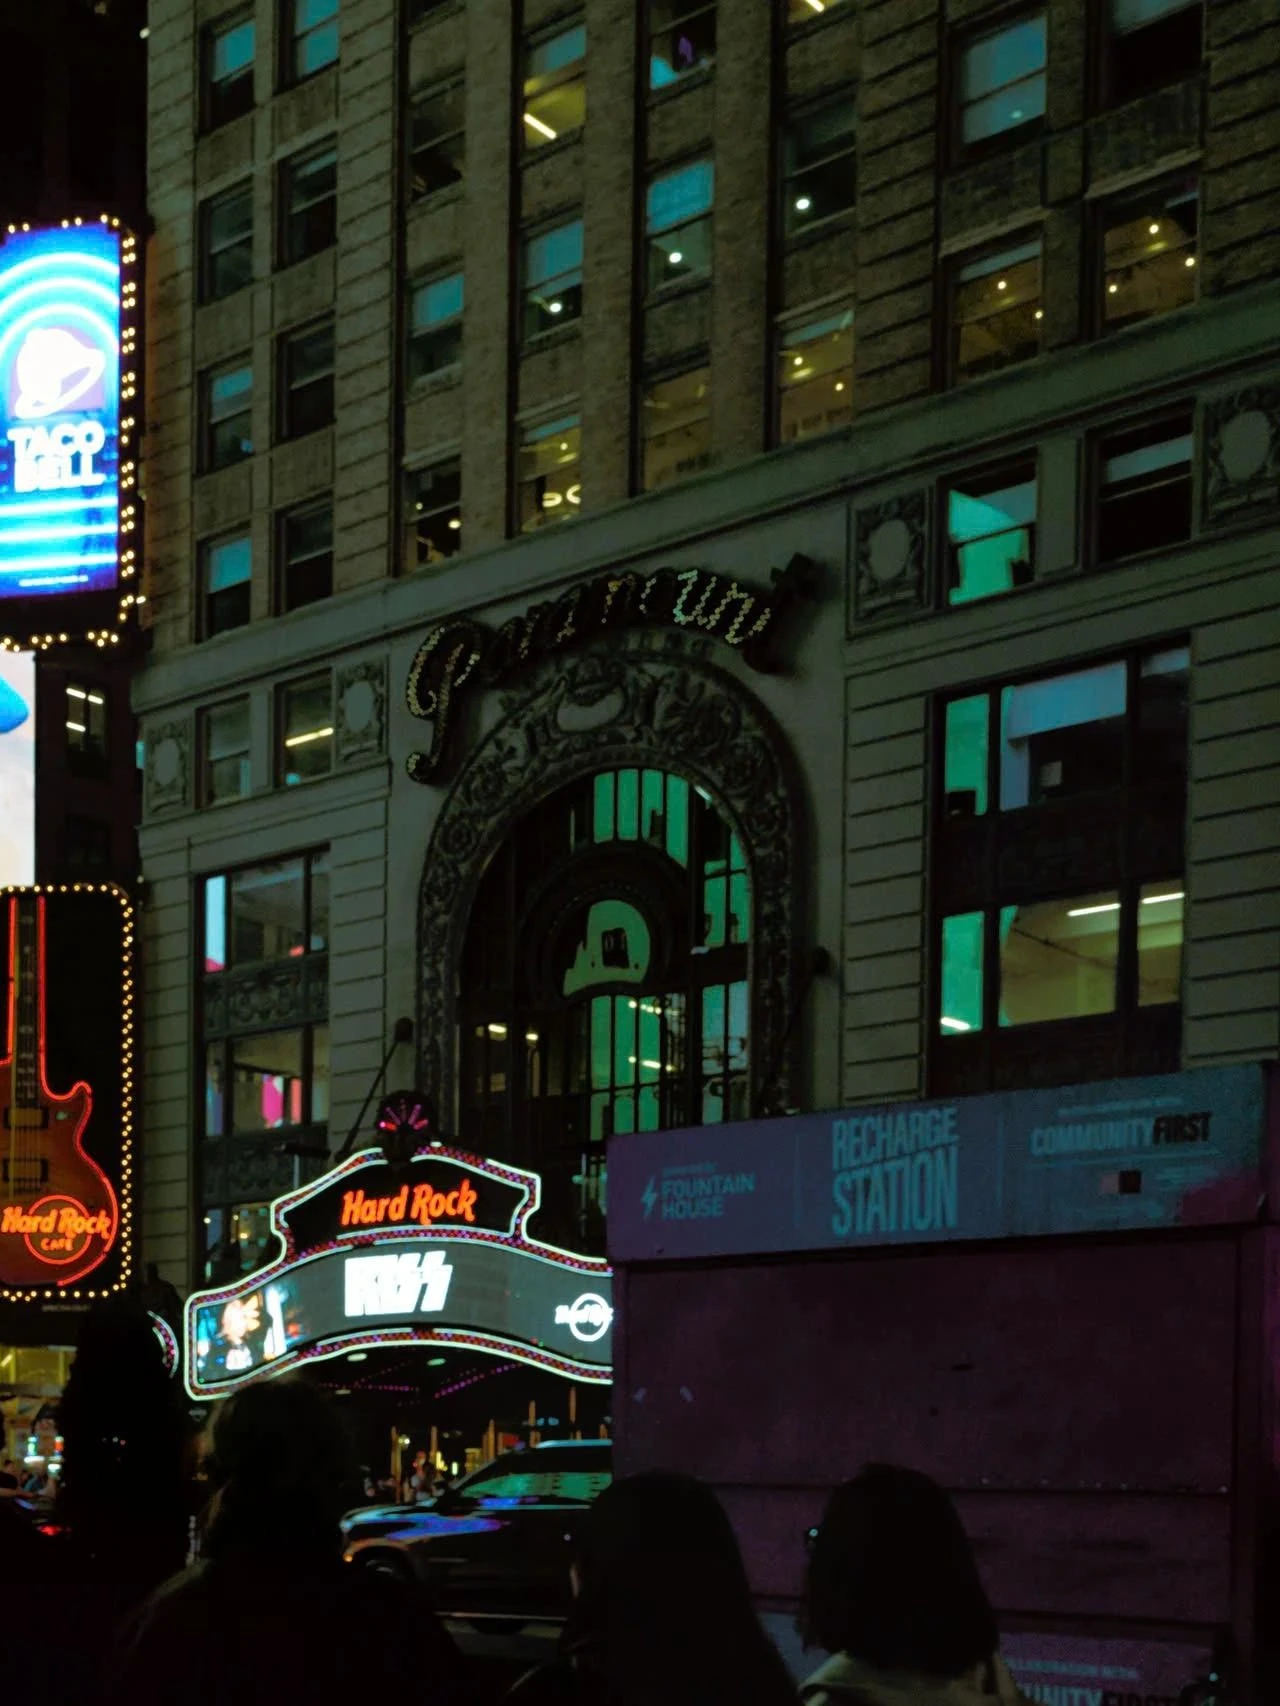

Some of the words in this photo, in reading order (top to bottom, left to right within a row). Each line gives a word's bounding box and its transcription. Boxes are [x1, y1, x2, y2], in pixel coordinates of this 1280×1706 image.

[7, 421, 105, 461] TACO
[14, 454, 106, 492] BELL
[832, 1107, 960, 1170] RECHARGE
[341, 1184, 409, 1225] Hard
[411, 1178, 478, 1225] Rock
[662, 1171, 756, 1199] FOUNTAIN
[832, 1144, 959, 1237] STATION
[1, 1206, 58, 1233] Hard
[58, 1207, 112, 1240] Rock
[662, 1196, 725, 1221] HOUSE
